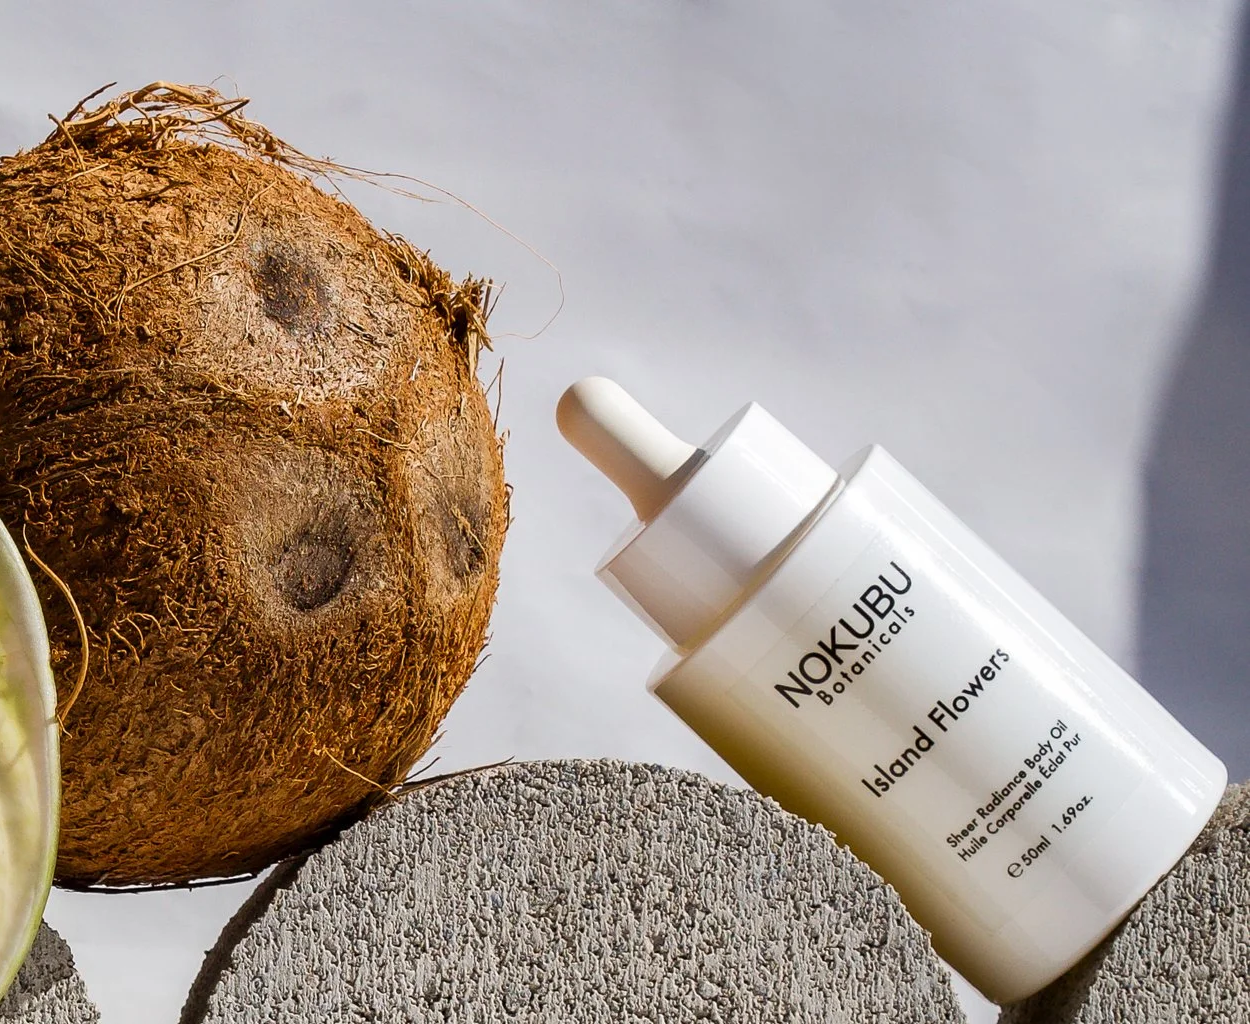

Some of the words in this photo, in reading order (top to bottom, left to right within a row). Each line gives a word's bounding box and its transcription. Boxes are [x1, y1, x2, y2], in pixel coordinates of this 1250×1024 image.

[773, 560, 913, 709] NOKUBU
[815, 606, 915, 706] Botanicals
[860, 724, 936, 798] Island
[927, 648, 1010, 733] Flowers
[946, 817, 979, 848] Sheer
[975, 769, 1028, 820] Radiance
[1023, 739, 1054, 770] Body
[1049, 719, 1069, 740] Oil
[957, 835, 989, 862] Huile
[985, 779, 1043, 835] Corporelle
[1038, 750, 1067, 780] Éclat
[1062, 732, 1082, 753] Pur
[1051, 795, 1094, 834] 1.69oz.
